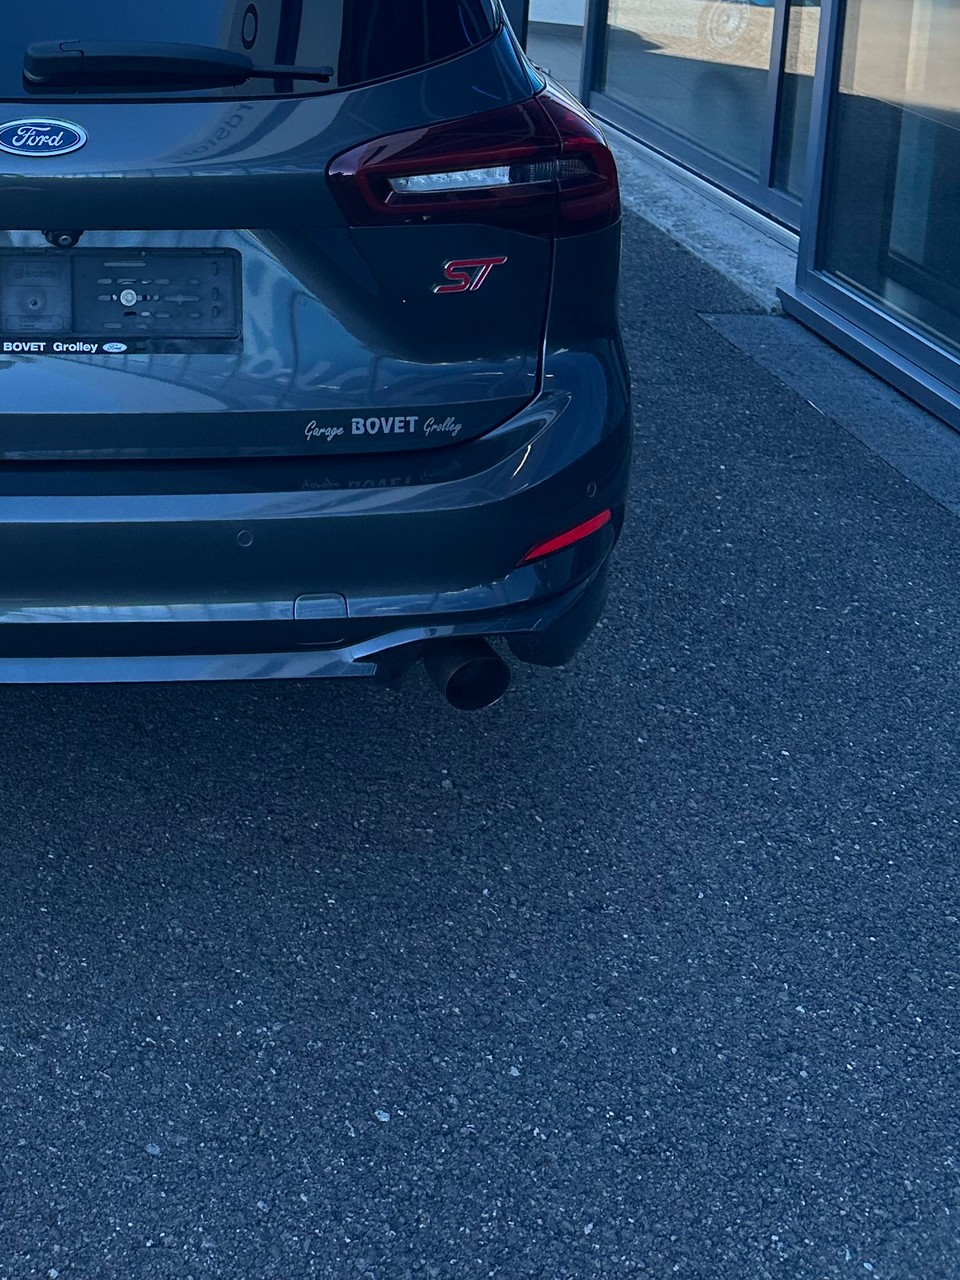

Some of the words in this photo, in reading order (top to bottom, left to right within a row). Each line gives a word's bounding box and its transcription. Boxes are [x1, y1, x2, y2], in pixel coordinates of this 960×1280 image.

[12, 126, 65, 147] Ford
[432, 255, 508, 294] ST
[3, 342, 46, 352] BOVET
[53, 341, 99, 354] Grolley
[304, 420, 345, 442] Garage
[351, 415, 419, 435] BOVET
[423, 416, 462, 437] Grolley
